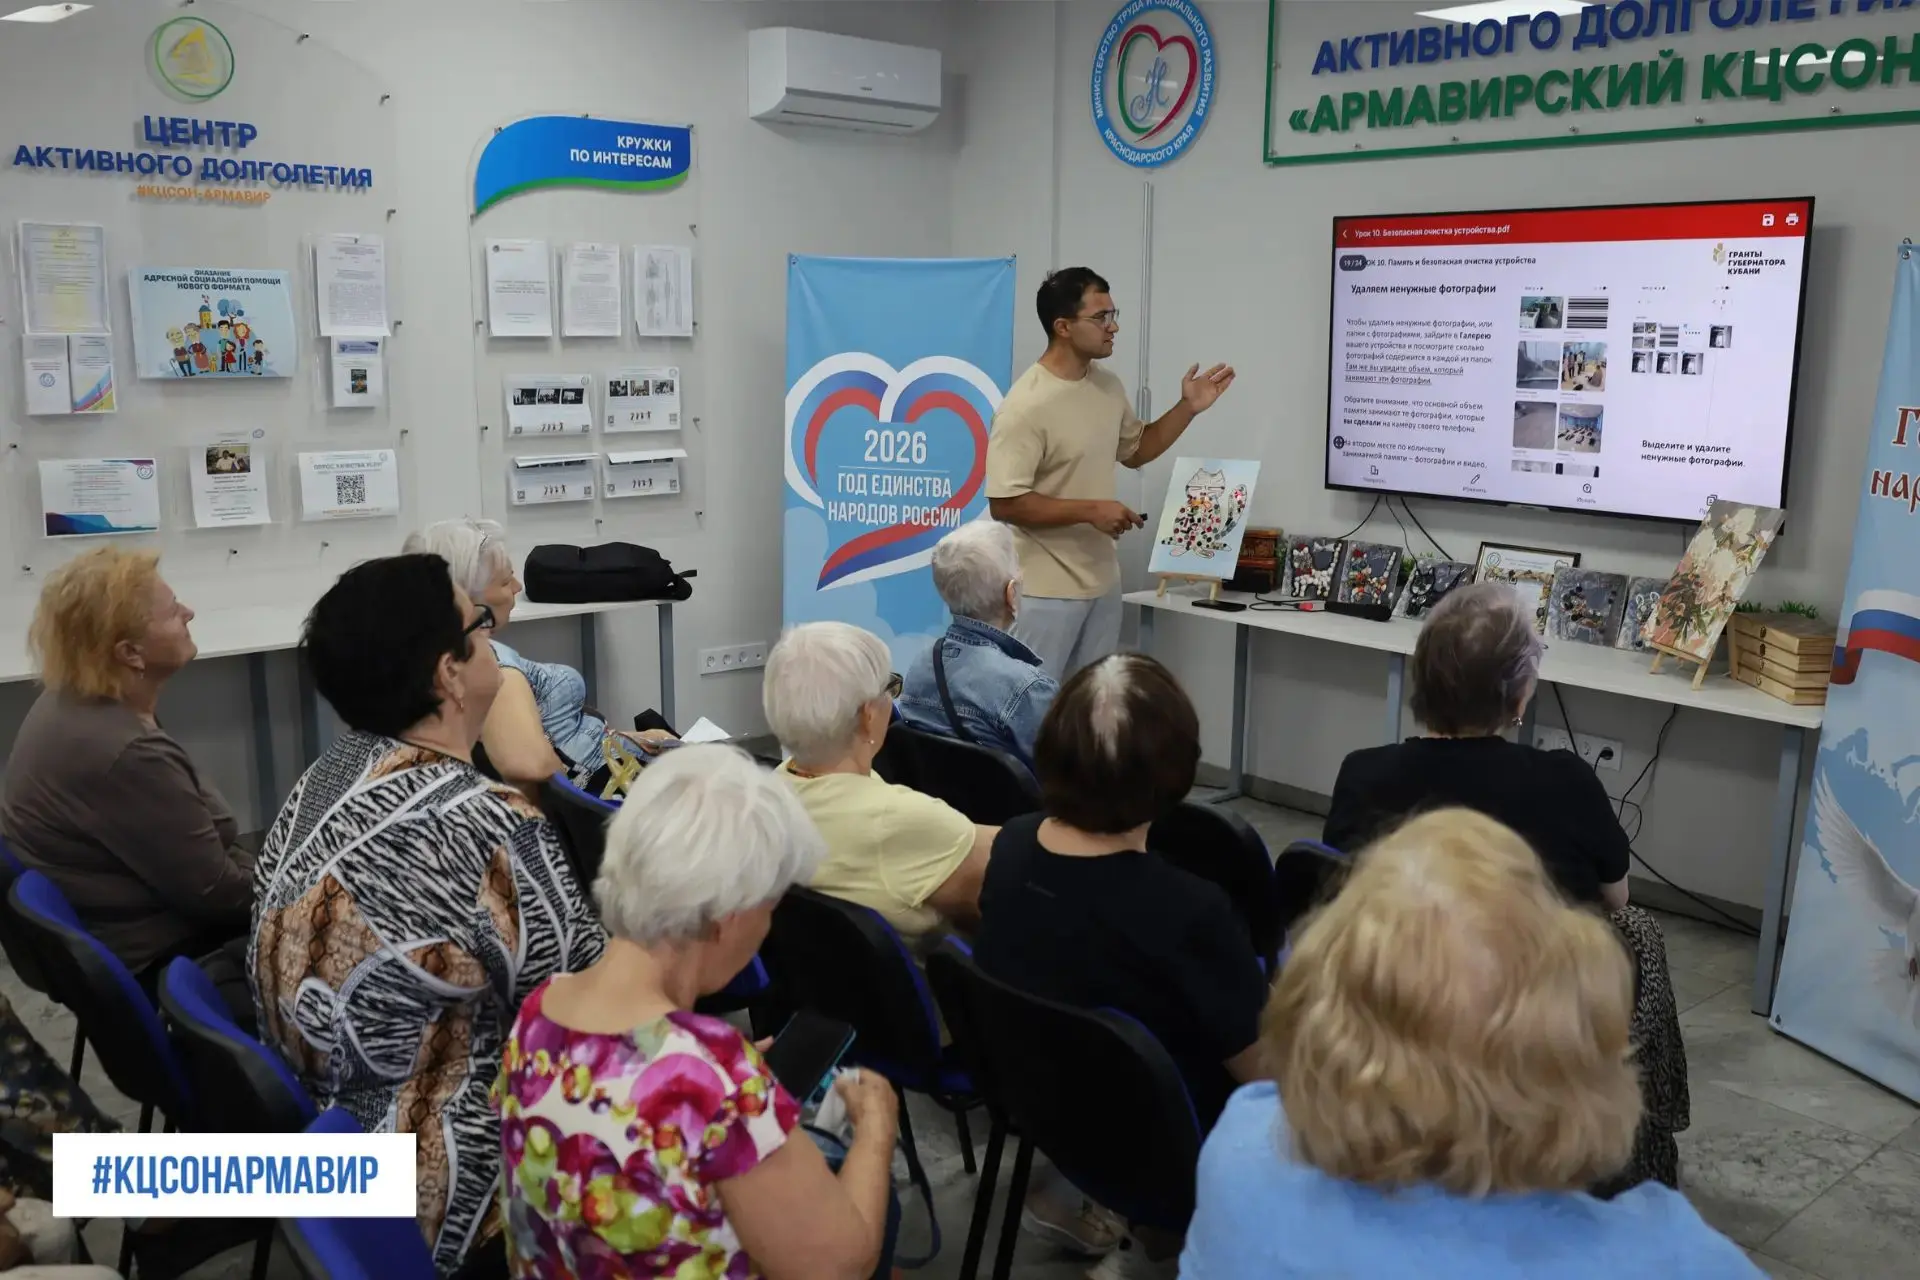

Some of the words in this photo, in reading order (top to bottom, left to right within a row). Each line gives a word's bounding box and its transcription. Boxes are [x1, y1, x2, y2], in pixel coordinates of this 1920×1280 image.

[1311, 10, 1561, 75] АКТИВНОГО
[1092, 23, 1118, 119] МИНИСТЕРСТВО
[1117, 0, 1144, 24] ТРУДА
[1196, 49, 1211, 117] РАЗВИТИЯ
[1288, 49, 1684, 134] «АРМАВИРСКИЙ
[1701, 33, 1920, 101] КЦСОН
[143, 115, 257, 149] ЦЕНТР
[617, 135, 672, 152] КРУЖКИ
[1103, 128, 1173, 163] КРАСНОДАРСКОГО
[1173, 125, 1194, 150] КРАЯ
[570, 148, 590, 162] ПО
[593, 150, 672, 169] ИНТЕРЕСАМ
[13, 145, 192, 177] АКТИВНОГО
[200, 158, 372, 187] ДОЛГОЛЕТИЯ
[136, 184, 271, 203] #КЦСОН-АРМАВИР
[1355, 230, 1371, 238] Урок
[1373, 229, 1381, 237] 10.
[1383, 229, 1423, 237] Безопасная
[1424, 228, 1453, 236] очистка
[1454, 225, 1510, 236] устройства.pdf
[1421, 258, 1462, 266] безопасная
[1495, 256, 1536, 266] устройства
[144, 273, 188, 282] АДРЕСНОЙ
[189, 275, 243, 284] СОЦИАЛЬНОЙ
[244, 277, 281, 285] ПОМОЩИ
[194, 269, 231, 277] ОКАЗАНИЕ
[211, 283, 251, 291] ФОРМАТА
[1351, 285, 1388, 295] Удаляем
[1390, 285, 1436, 295] ненужные
[1439, 284, 1496, 295] фотографии
[1346, 318, 1367, 326] Чтобы
[1432, 320, 1476, 328] фотографии,
[1424, 331, 1452, 339] зайдите
[1459, 332, 1492, 340] Галерею
[1370, 341, 1406, 349] устройства
[1413, 343, 1453, 351] посмотрите
[1345, 351, 1384, 360] фотографий
[1432, 355, 1459, 363] каждой
[1433, 366, 1464, 374] который
[1343, 395, 1374, 404] Обратите
[1424, 400, 1458, 408] основной
[1459, 402, 1483, 410] объем
[1354, 419, 1381, 427] сделали
[1392, 422, 1416, 430] камеру
[1455, 414, 1486, 422] которые
[864, 429, 927, 464] 2026
[1377, 442, 1396, 450] месте
[1407, 445, 1446, 455] количеству
[1642, 440, 1685, 450] Выделите
[1695, 445, 1731, 453] удалите
[1414, 456, 1455, 465] фотографии
[1641, 453, 1687, 463] ненужные
[1688, 456, 1746, 467] фотографии.
[838, 472, 868, 497] ГОД
[871, 473, 952, 498] ЕДИНСТВА
[828, 500, 898, 526] НАРОДОВ
[902, 503, 961, 528] РОССИИ
